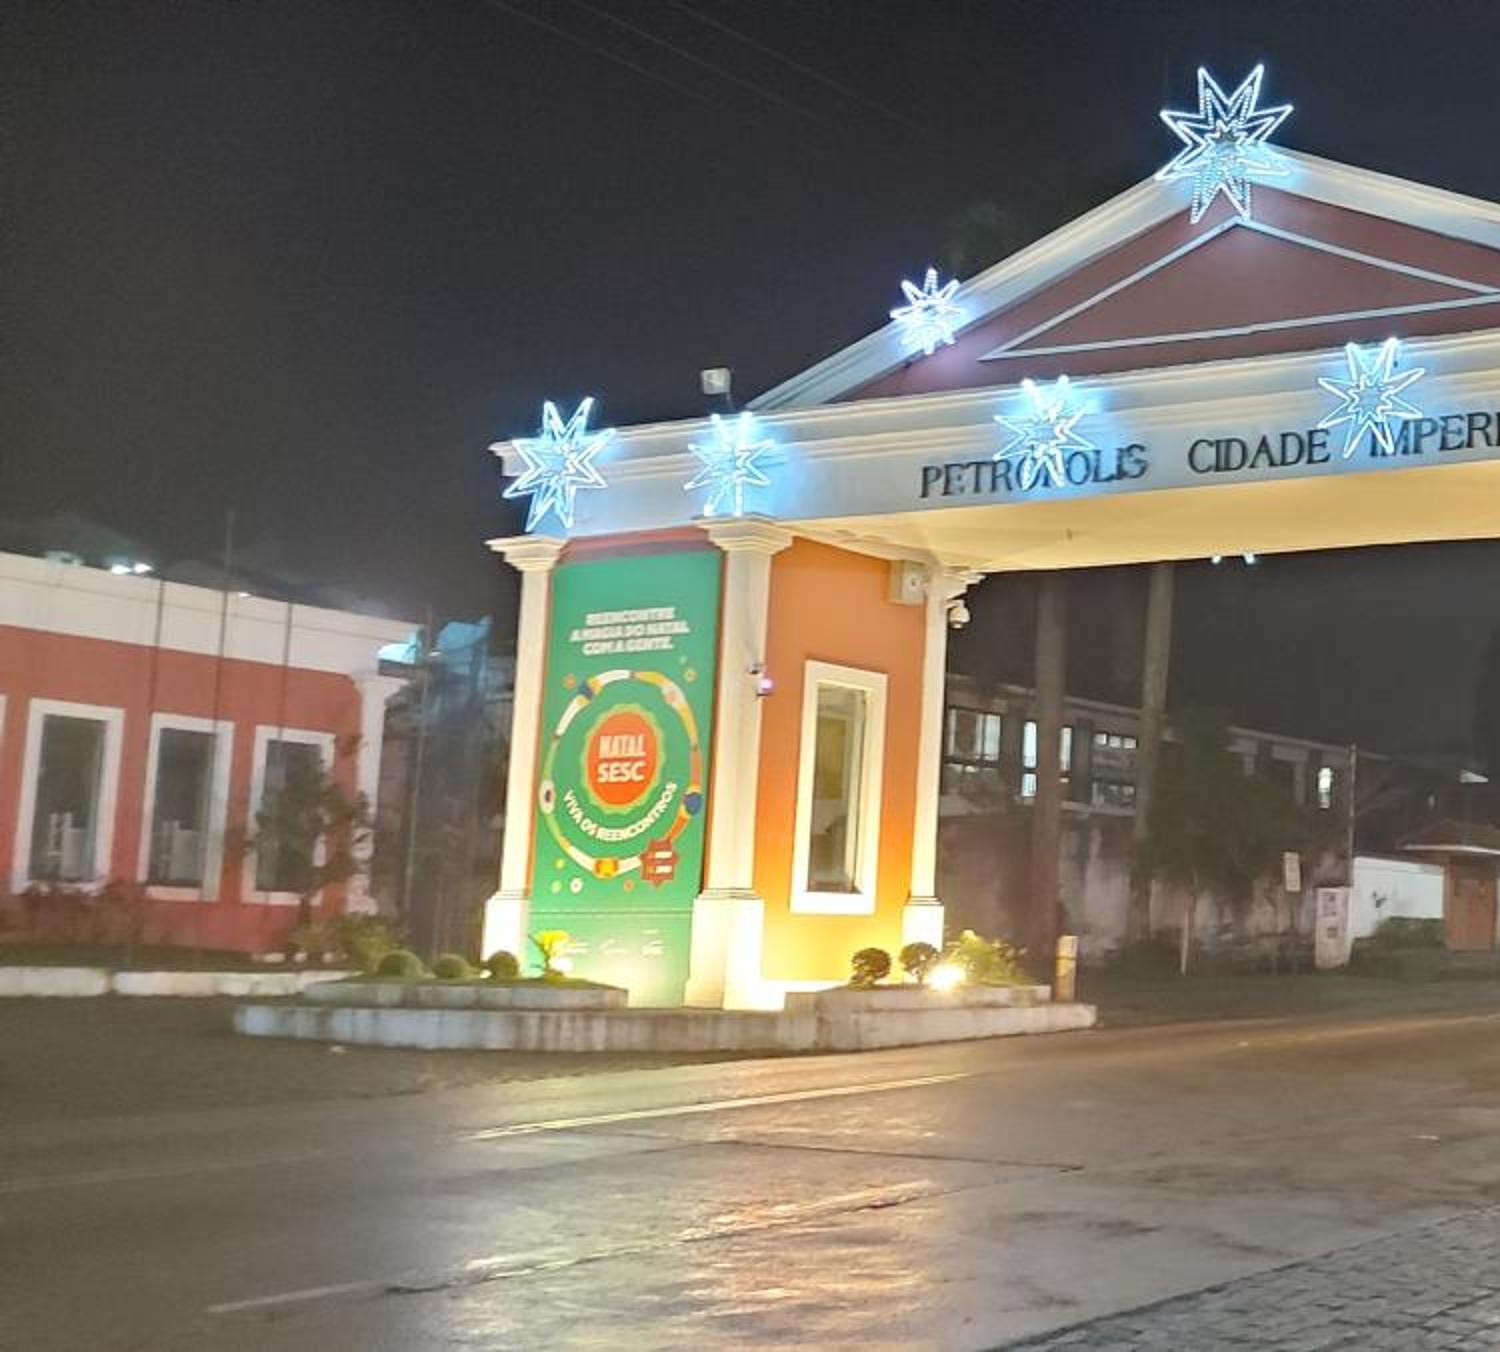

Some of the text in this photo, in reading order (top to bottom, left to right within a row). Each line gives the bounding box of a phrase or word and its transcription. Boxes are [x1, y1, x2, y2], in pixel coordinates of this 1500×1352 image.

[1187, 429, 1331, 474] CIDADE
[599, 734, 647, 758] NATAL
[597, 760, 647, 783] SESC
[563, 782, 678, 841] VIVA OS REENCONTROS
